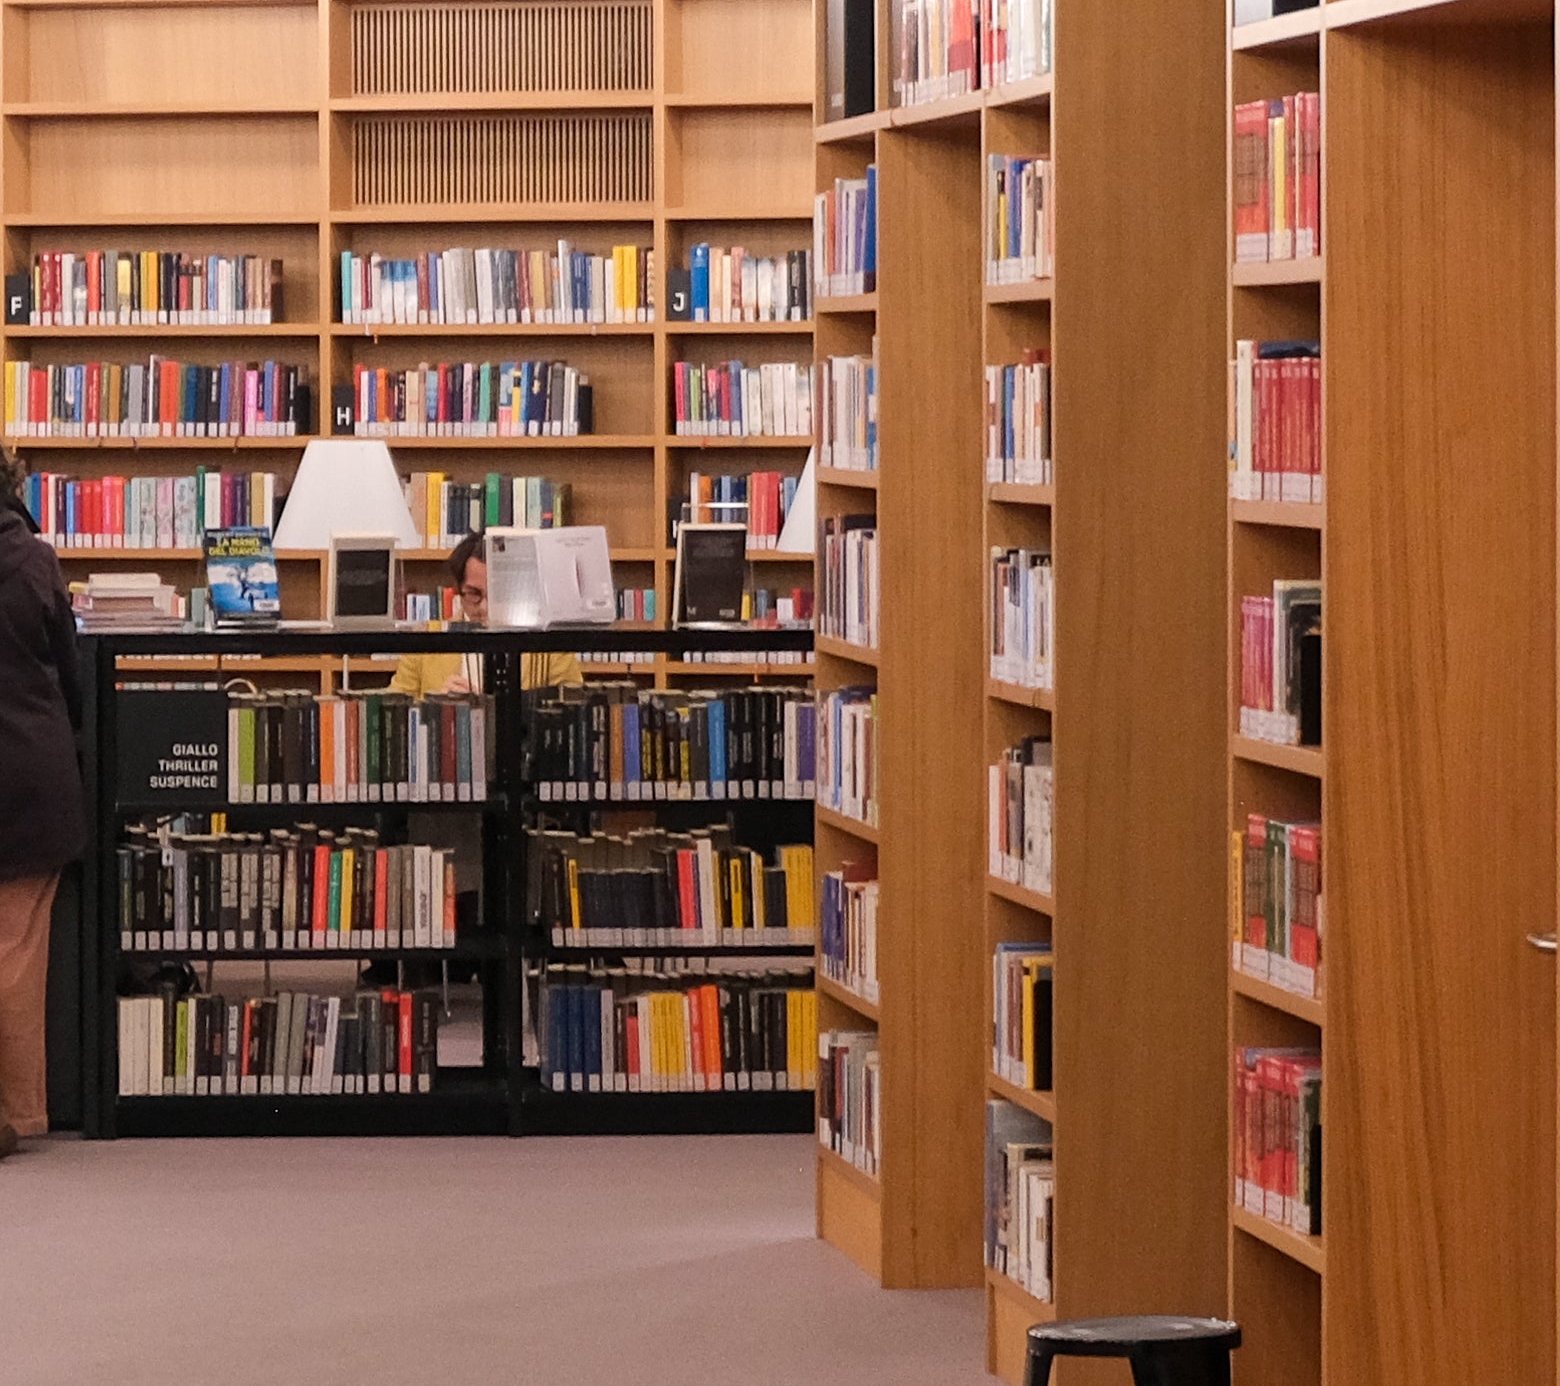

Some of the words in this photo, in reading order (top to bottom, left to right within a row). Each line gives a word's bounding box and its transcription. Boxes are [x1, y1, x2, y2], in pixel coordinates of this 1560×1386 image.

[11, 296, 22, 315] F
[673, 293, 684, 312] J
[337, 407, 350, 425] H
[172, 743, 217, 757] GIALLO
[159, 760, 217, 772] THRILLER
[149, 776, 218, 788] SUSPENCE
